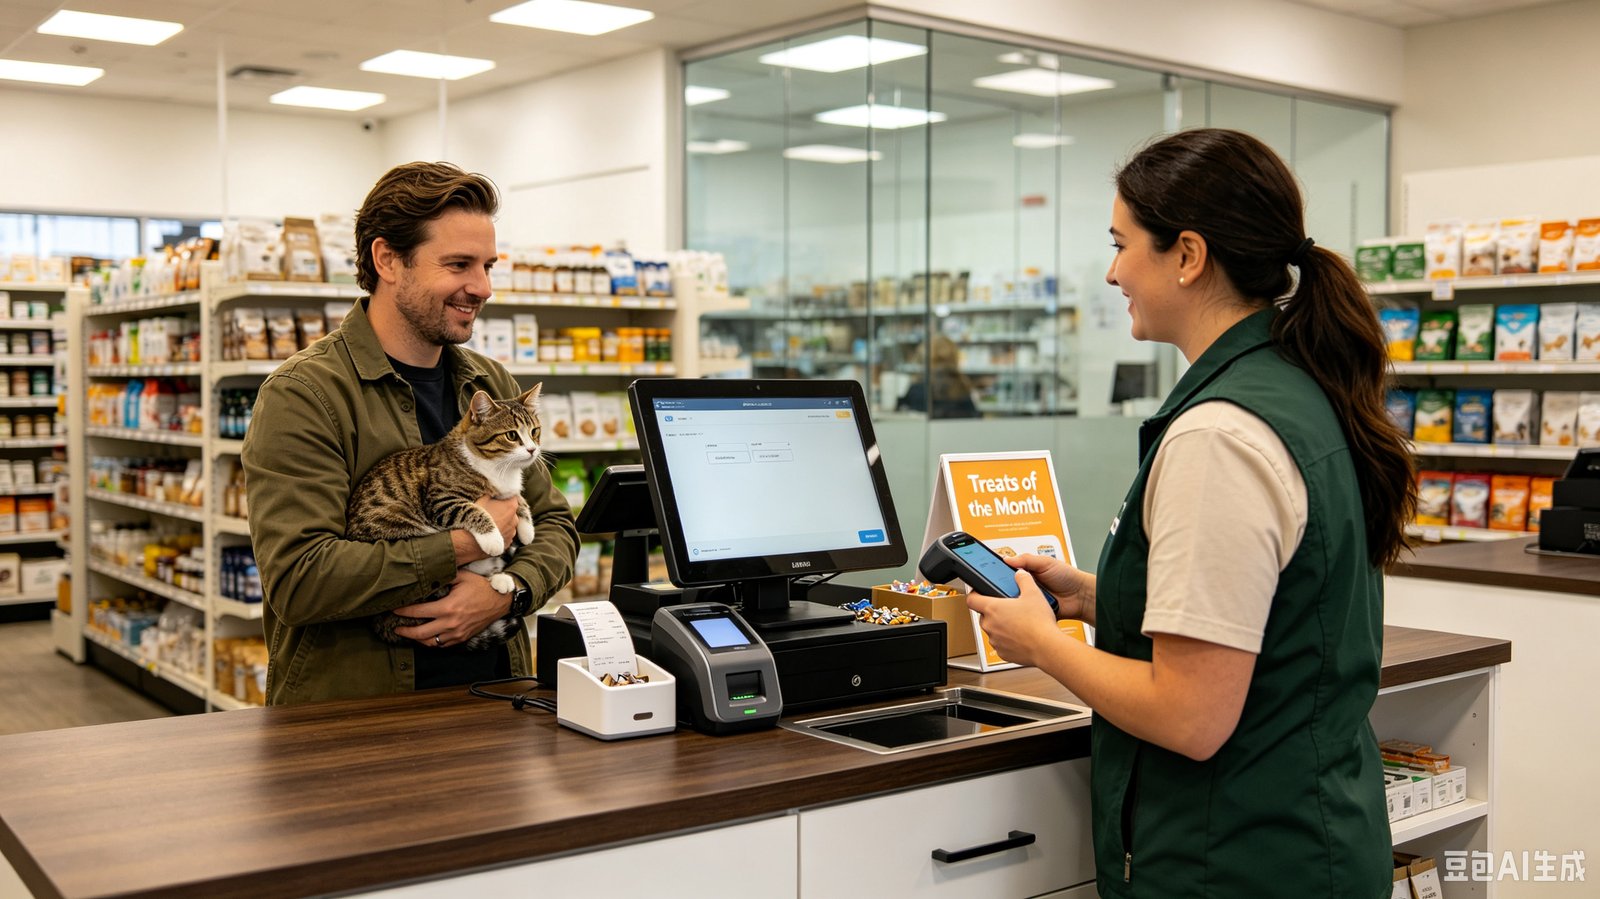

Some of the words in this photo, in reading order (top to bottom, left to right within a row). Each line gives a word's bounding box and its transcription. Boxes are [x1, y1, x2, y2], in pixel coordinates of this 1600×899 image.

[967, 473, 1020, 493] Treats
[1021, 470, 1037, 491] of
[968, 499, 993, 518] the
[994, 494, 1045, 516] Month
